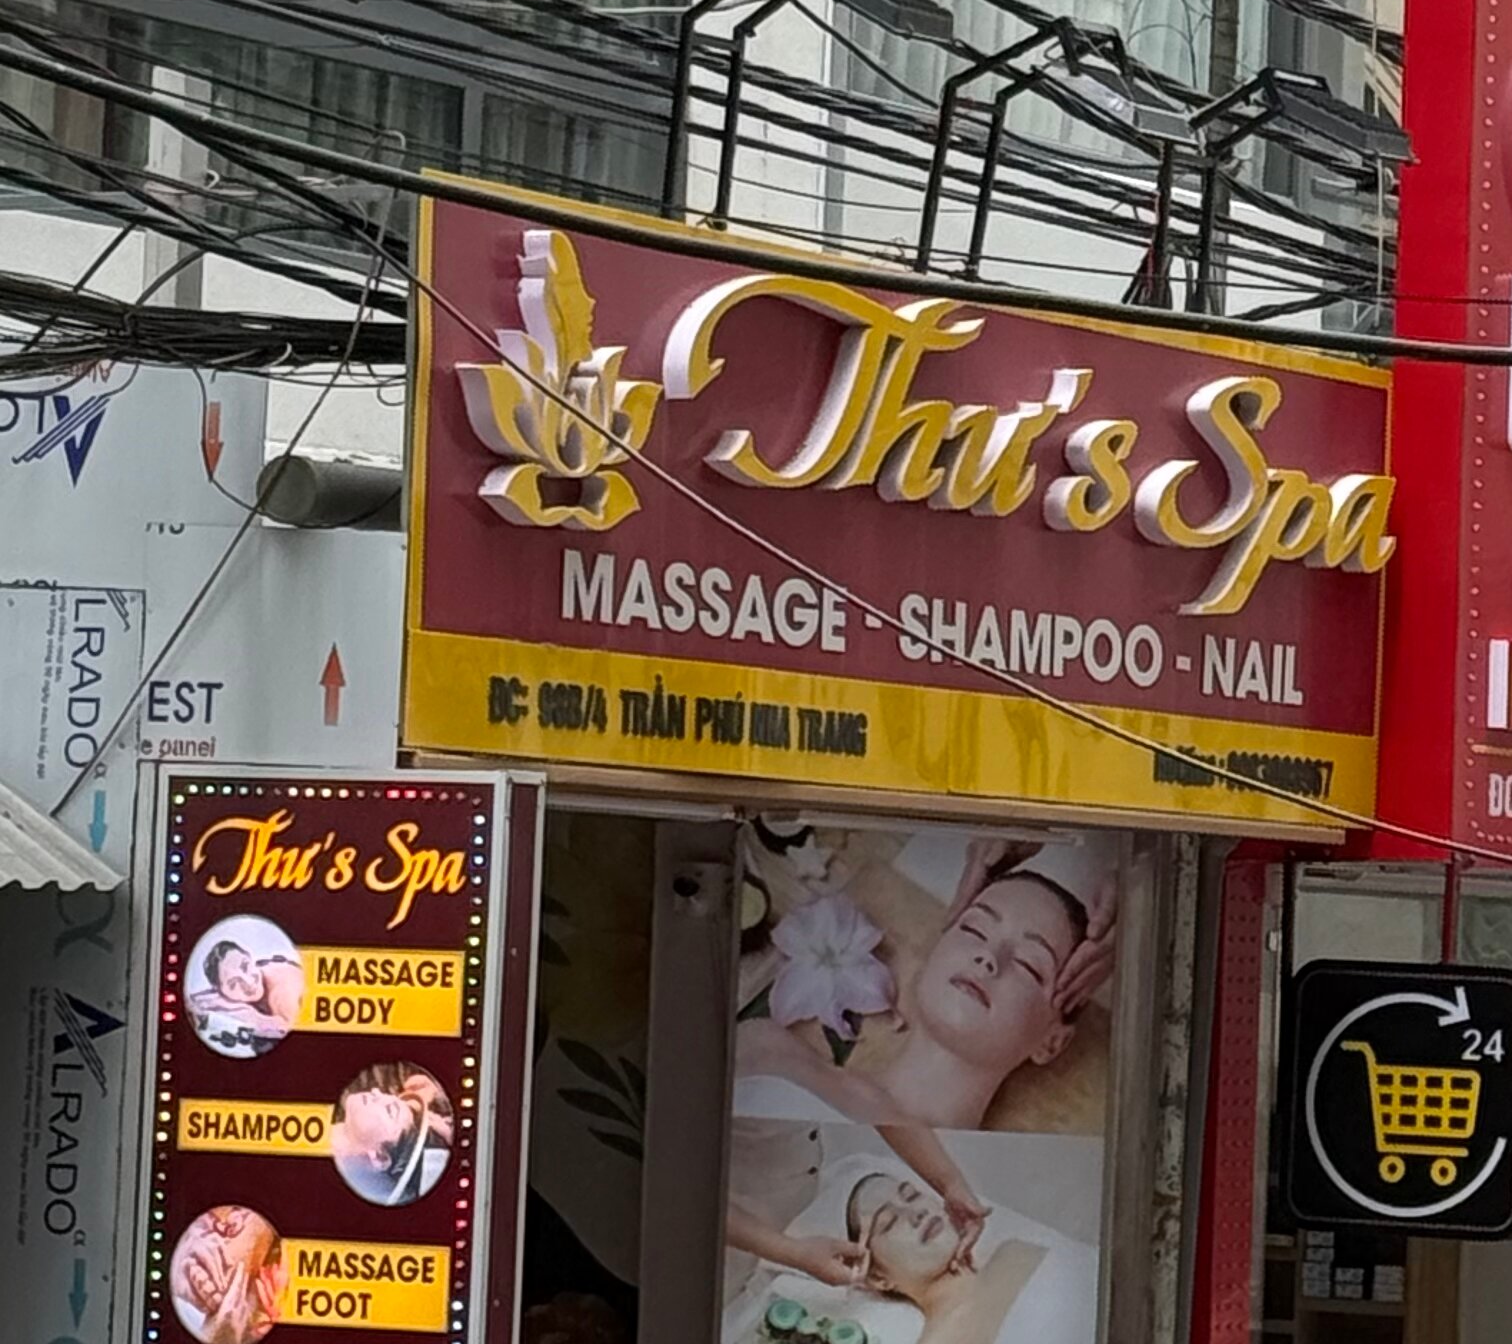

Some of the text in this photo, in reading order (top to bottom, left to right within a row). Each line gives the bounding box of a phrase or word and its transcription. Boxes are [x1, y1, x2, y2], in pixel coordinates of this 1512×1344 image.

[1133, 374, 1397, 617] Spa
[560, 549, 1305, 708] MASSAGE SHAMPOO NAIL
[363, 821, 466, 930] Spa
[315, 956, 456, 991] MASSAGE
[314, 997, 396, 1026] BODY
[1461, 1027, 1505, 1064] 24
[187, 1114, 325, 1145] SHAMPOO
[297, 1250, 436, 1285] MASSAGE
[296, 1291, 373, 1321] FOOT
